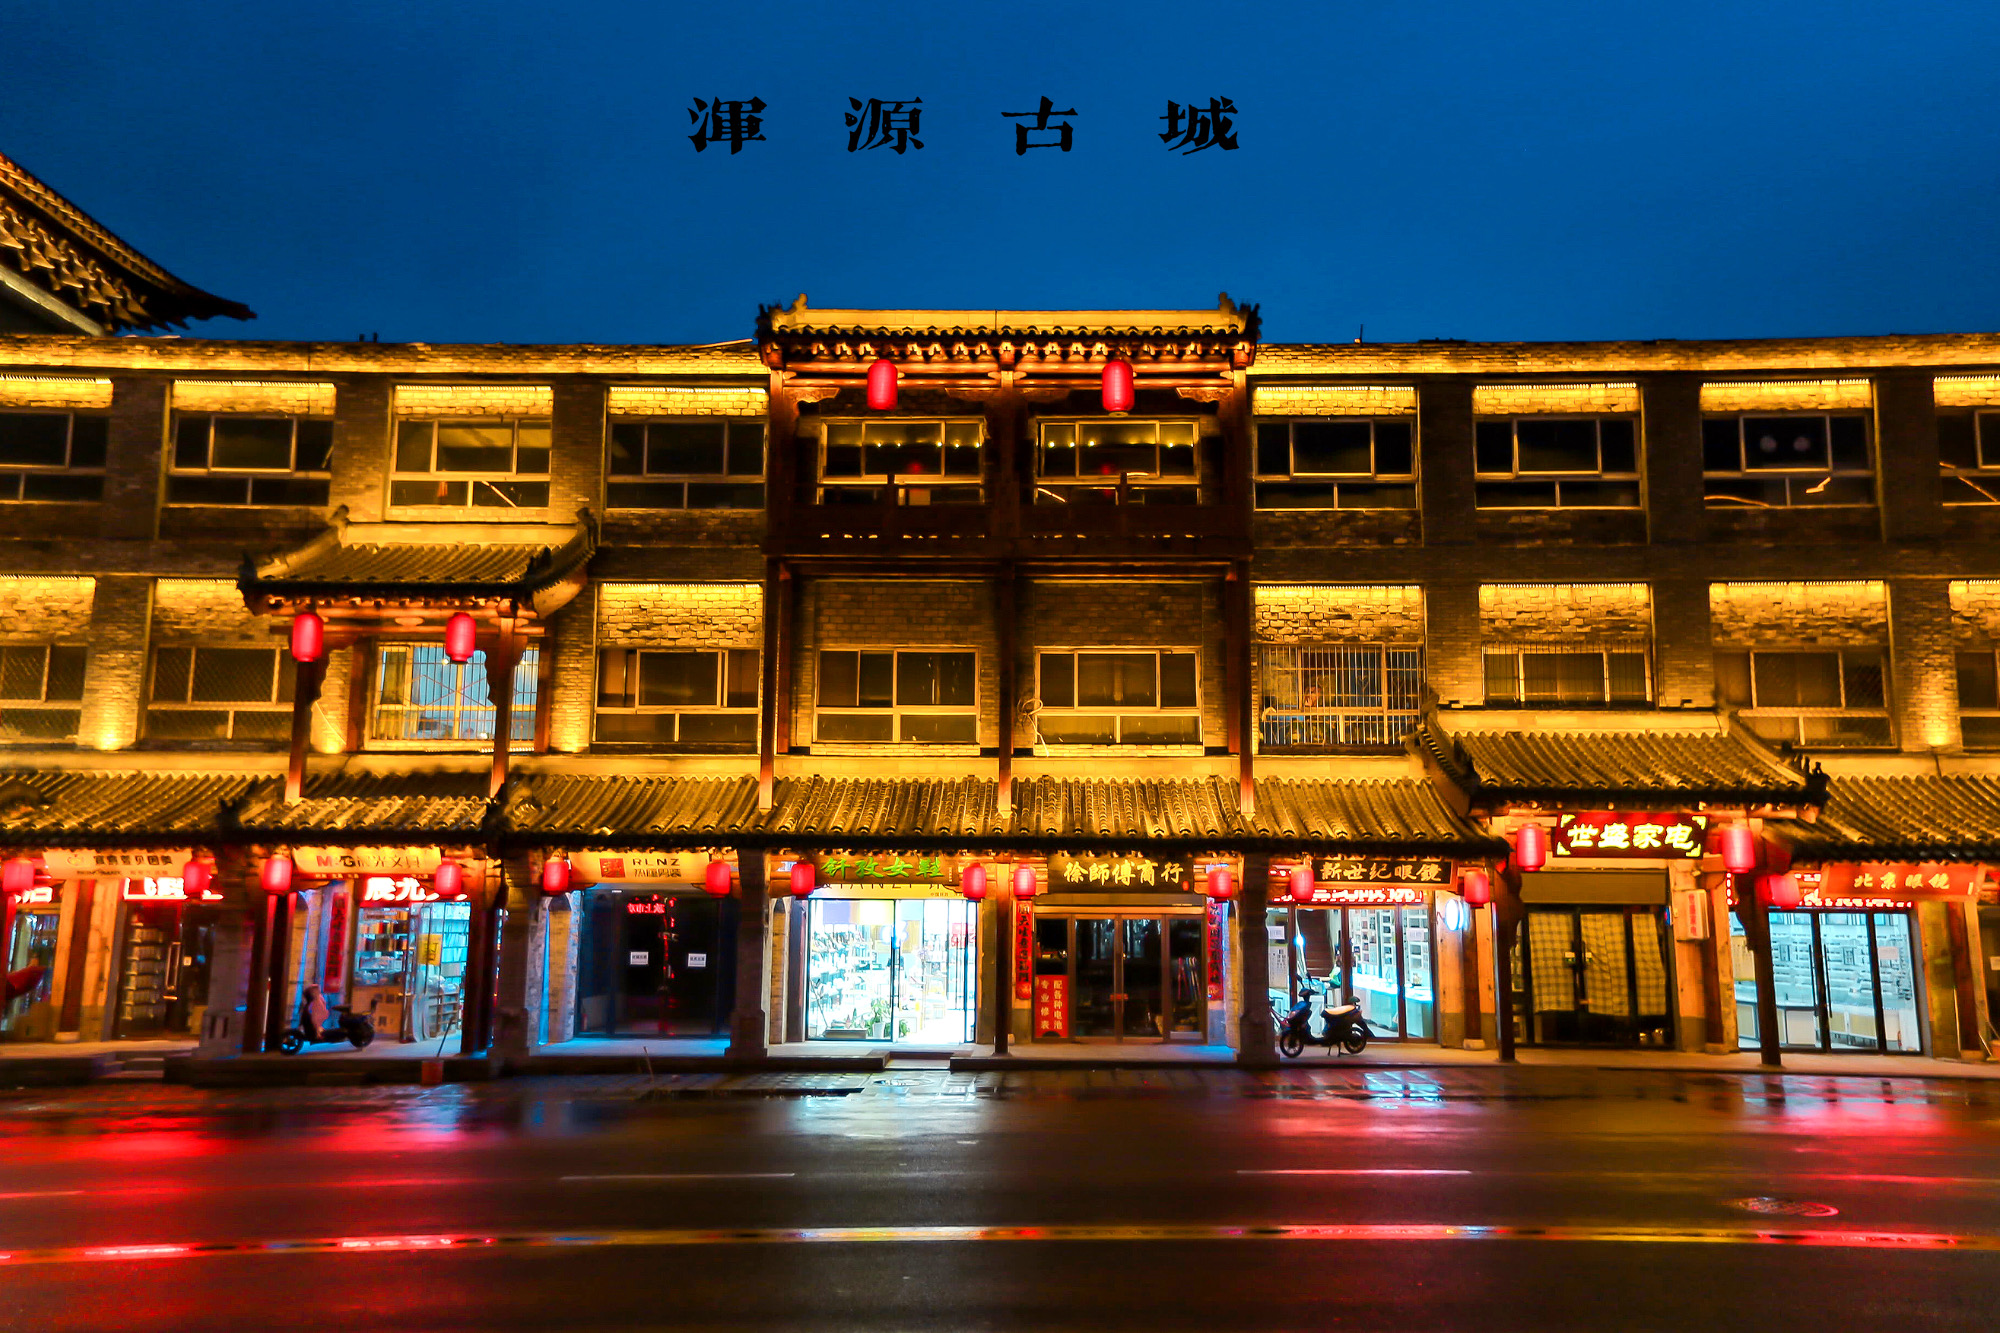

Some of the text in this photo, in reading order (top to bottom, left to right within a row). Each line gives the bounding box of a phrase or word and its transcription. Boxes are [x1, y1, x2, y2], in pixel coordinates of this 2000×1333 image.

[1567, 822, 1694, 850] 世盛家电
[632, 858, 680, 866] RLNZ
[1053, 979, 1063, 1030] 配各种电池
